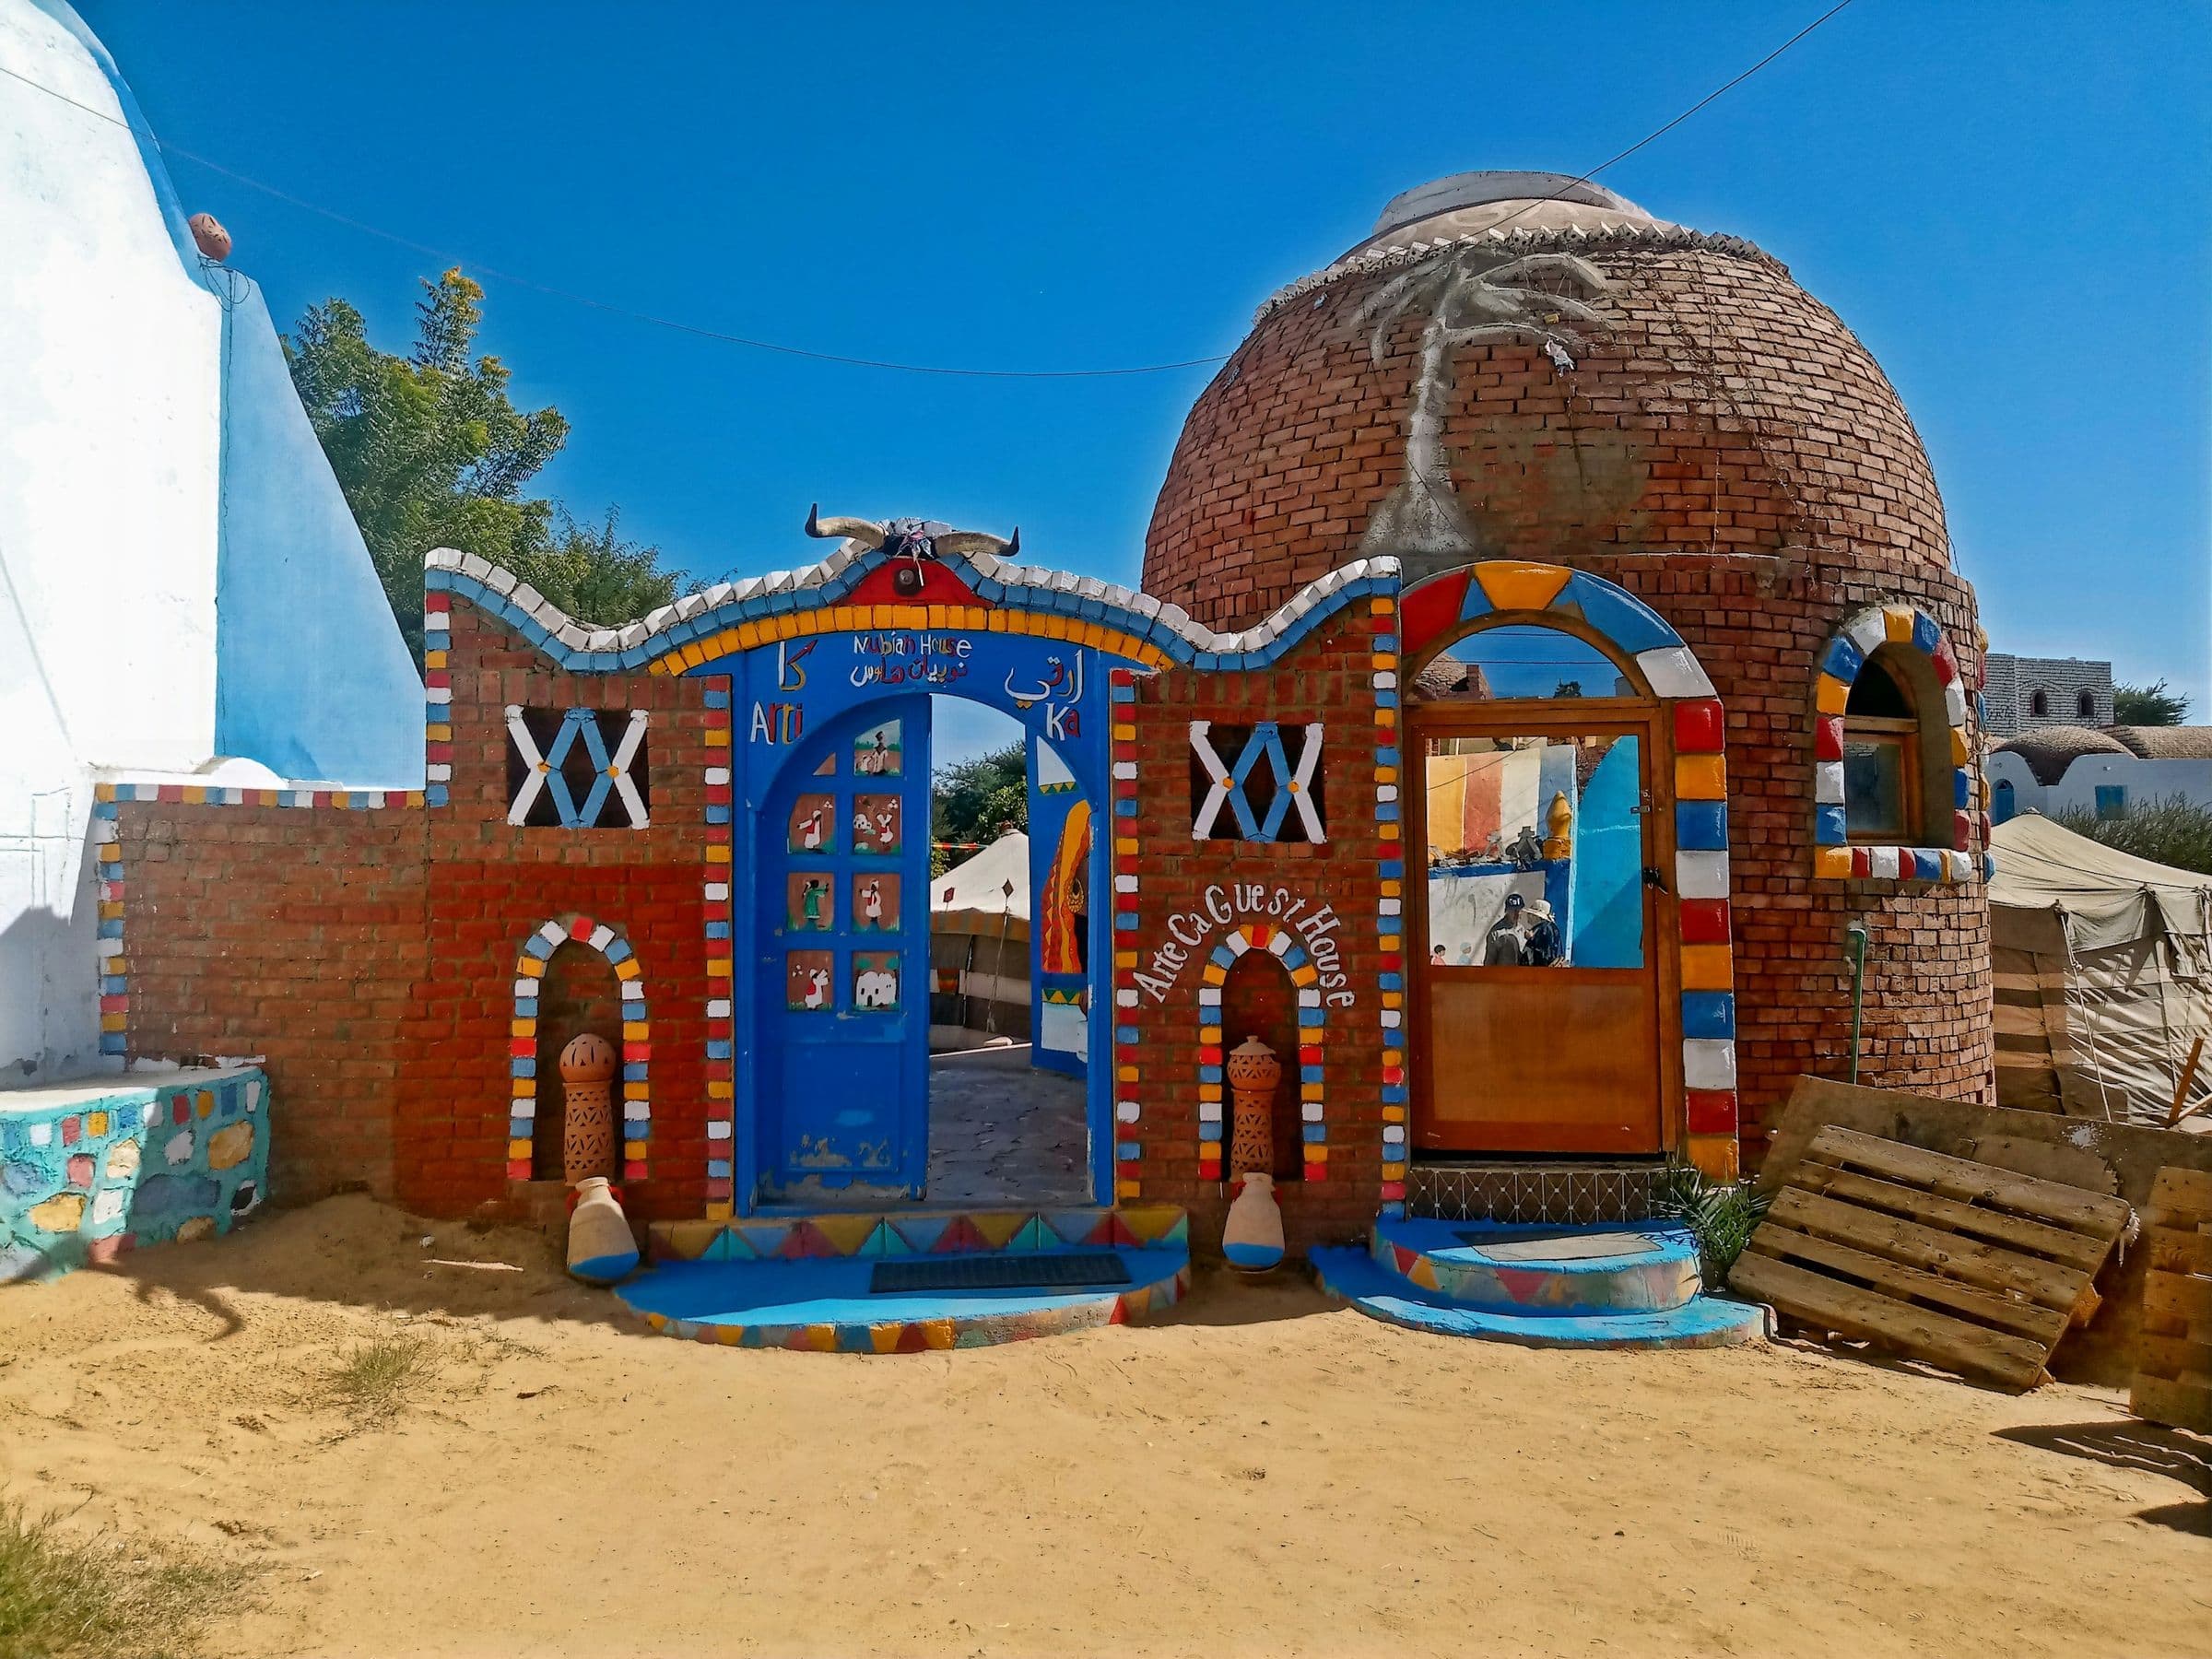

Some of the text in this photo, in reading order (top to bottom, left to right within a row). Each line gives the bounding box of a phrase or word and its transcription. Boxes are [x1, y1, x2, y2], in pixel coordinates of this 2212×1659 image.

[778, 640, 818, 691] كا
[853, 630, 972, 658] Nubian House
[850, 656, 905, 687] هاوس
[750, 700, 1081, 745] Arti Ka
[1205, 883, 1306, 924] Guest
[1295, 903, 1357, 1008] House
